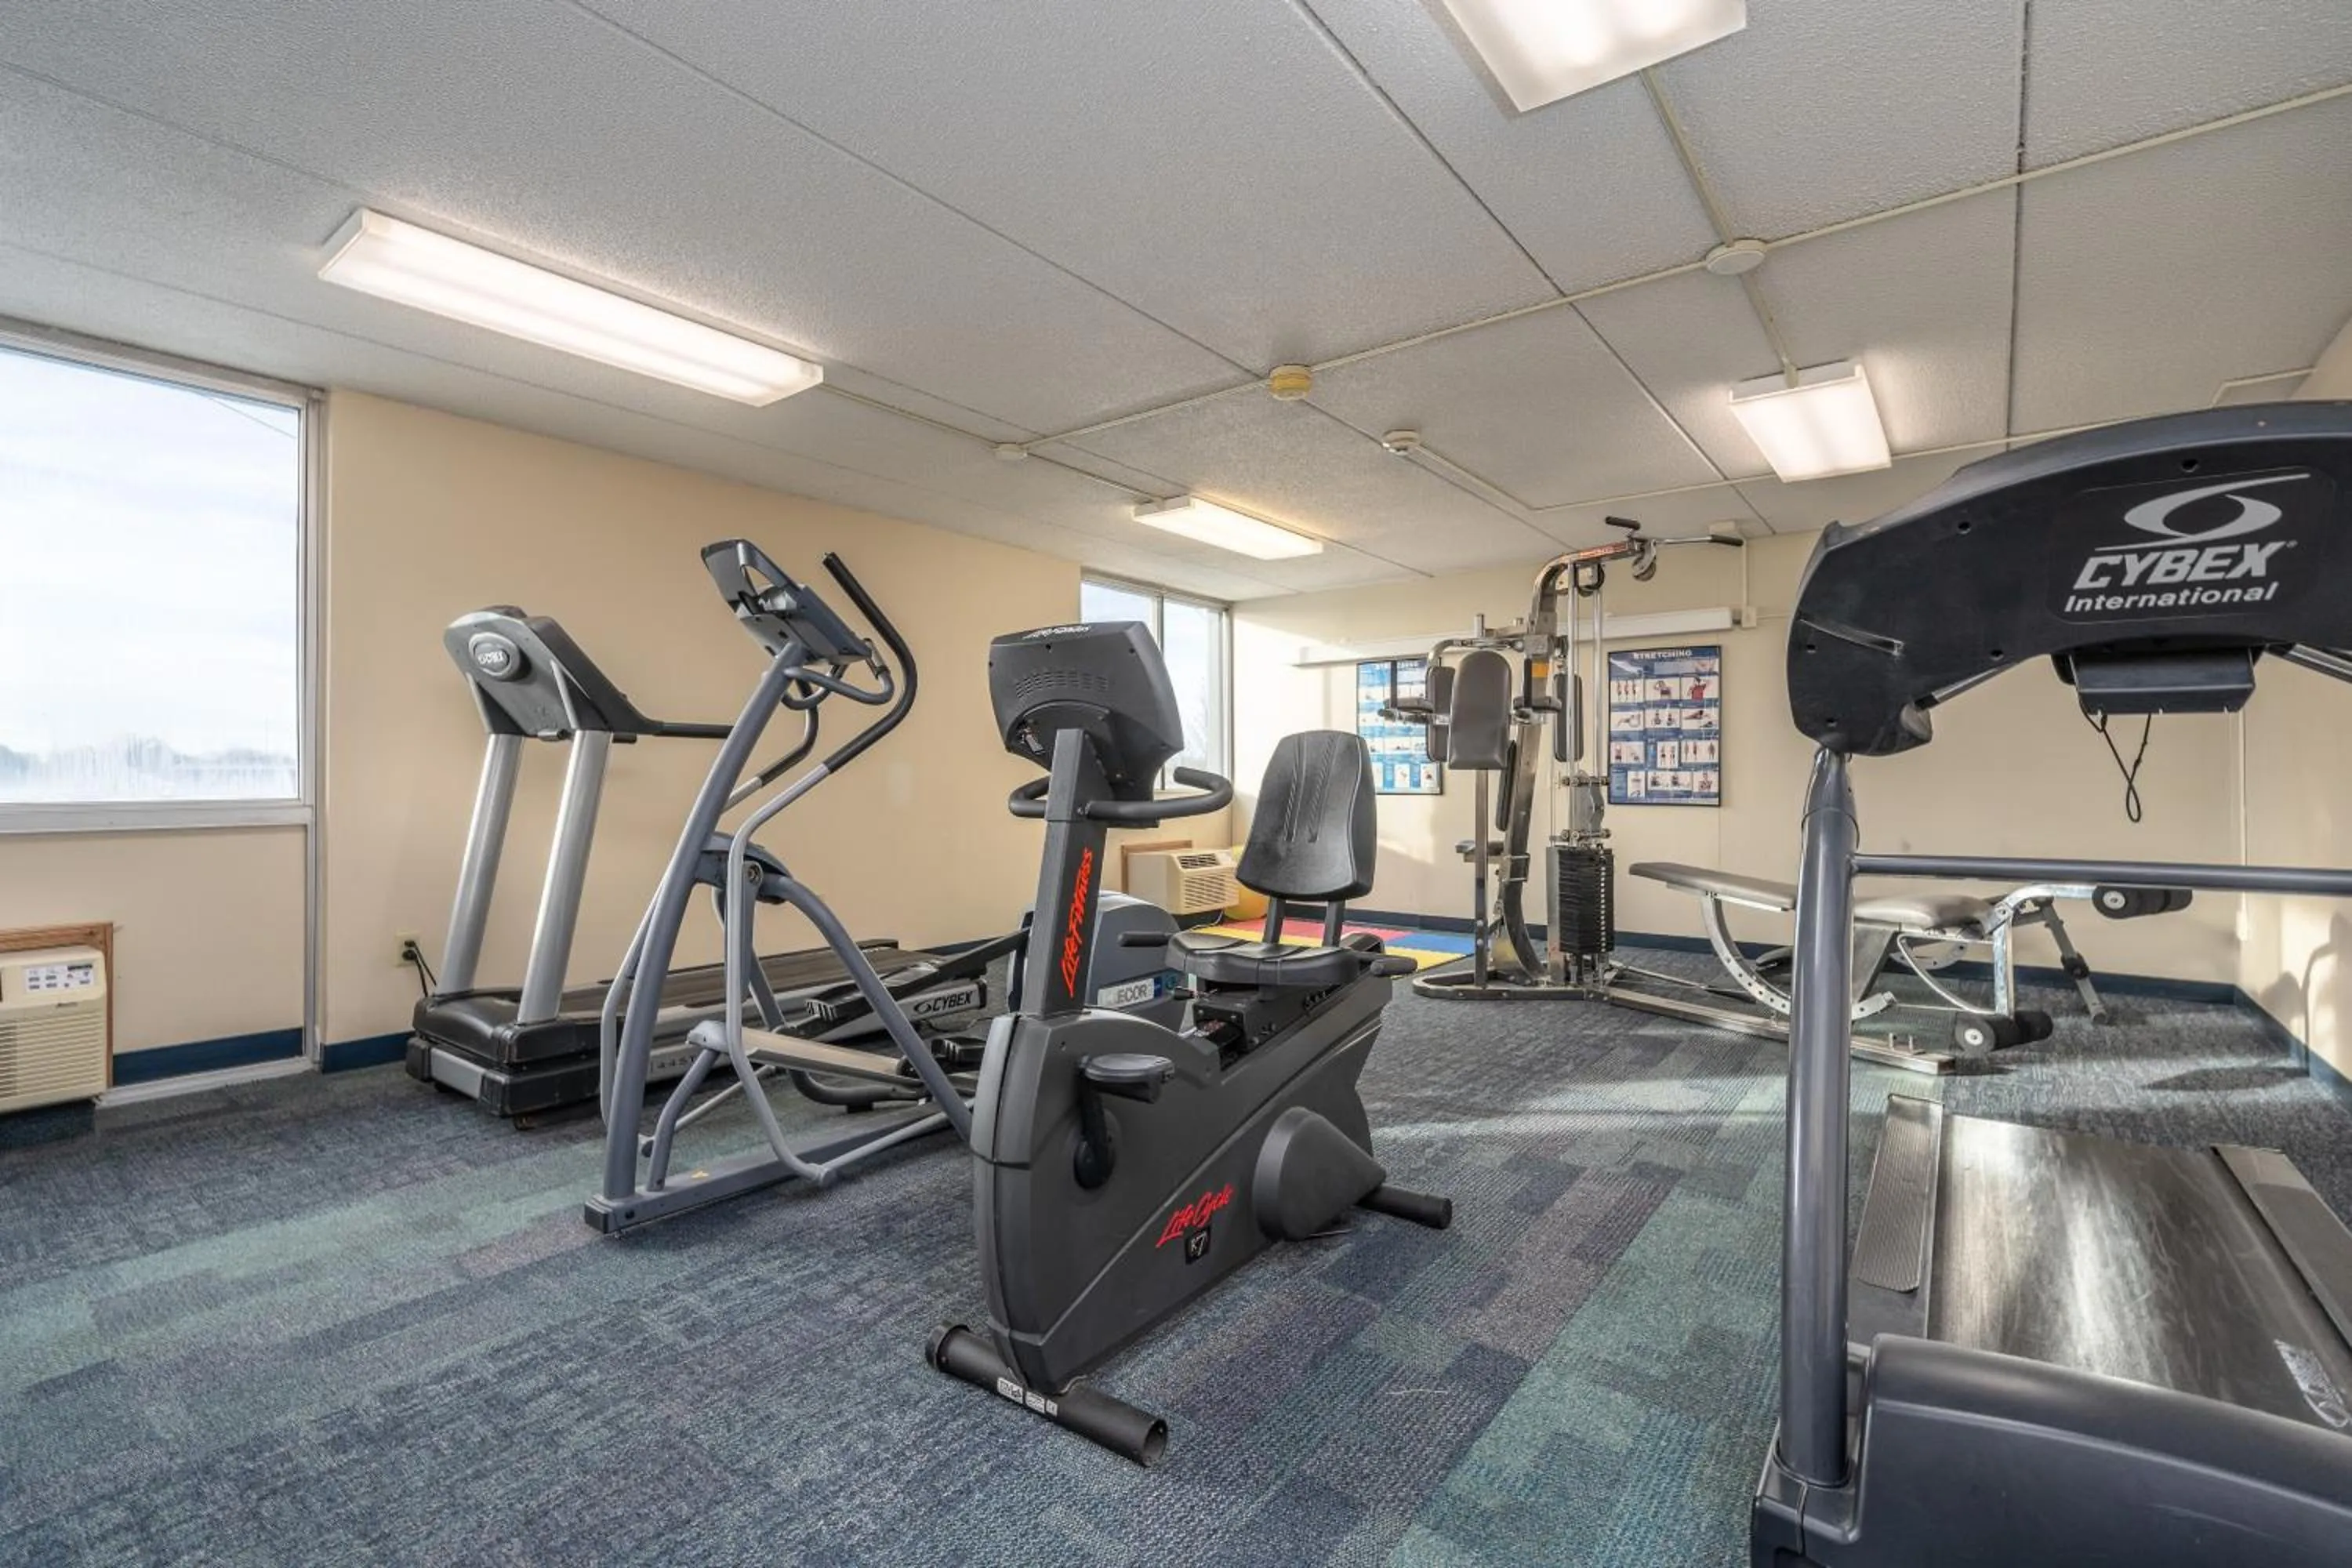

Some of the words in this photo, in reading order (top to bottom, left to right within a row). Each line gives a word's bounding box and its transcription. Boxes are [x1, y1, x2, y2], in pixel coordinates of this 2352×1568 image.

[2073, 541, 2287, 590] CYBEX
[2064, 581, 2279, 612] International
[931, 989, 974, 1012] CYBEX
